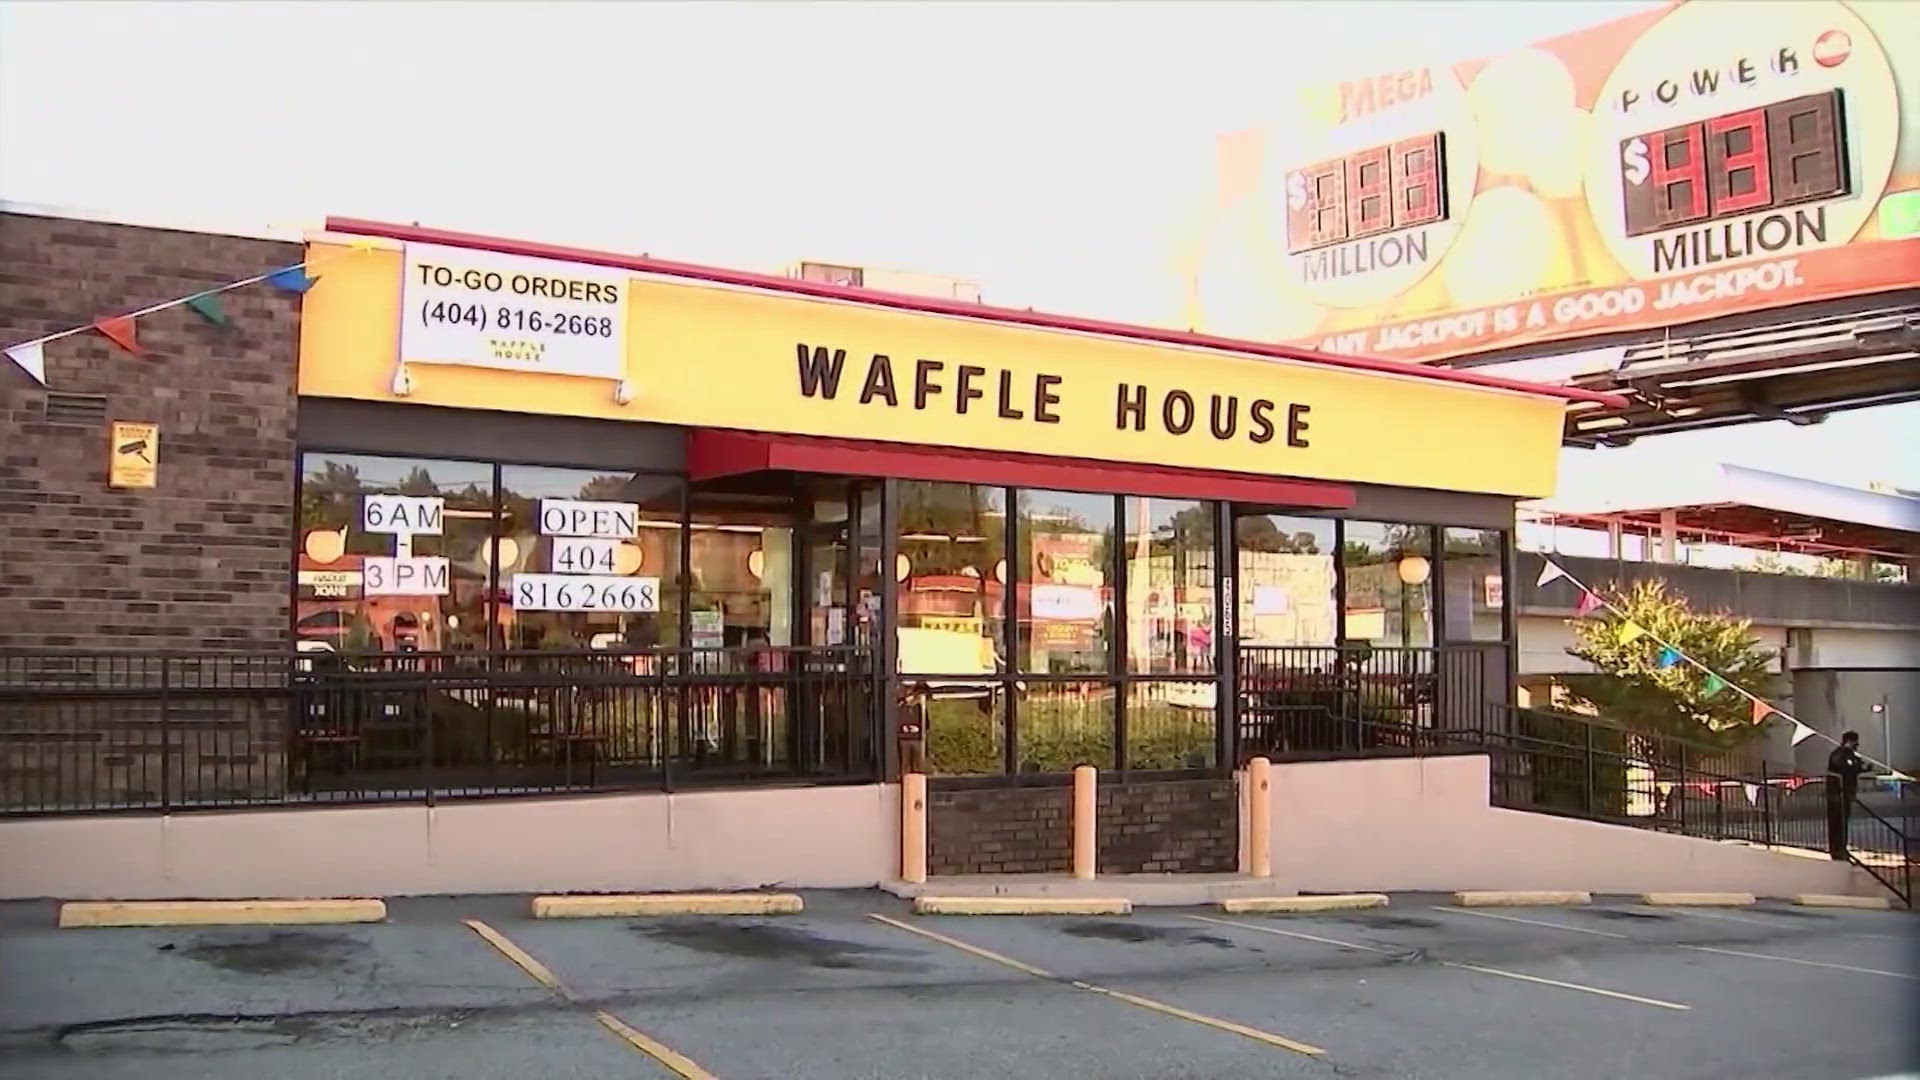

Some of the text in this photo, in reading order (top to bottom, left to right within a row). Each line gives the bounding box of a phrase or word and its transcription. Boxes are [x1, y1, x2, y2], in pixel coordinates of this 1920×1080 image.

[1338, 67, 1435, 121] MEGA
[1618, 47, 1799, 113] POWER
[1303, 231, 1428, 284] MILLION
[1654, 207, 1827, 273] MILLION
[417, 264, 618, 304] TO-GO ORDERS
[421, 299, 613, 338] (404) 816-2668
[1374, 311, 1487, 351] JACKPOT
[1493, 306, 1519, 333] IS
[1525, 302, 1546, 329] A
[1552, 287, 1646, 325] GOOD
[1654, 260, 1804, 310] JACKPOT.
[796, 343, 1312, 449] WAFFLE HOUSE
[366, 502, 442, 528] 6AM
[544, 507, 637, 534] OPEN
[367, 563, 448, 589] 3PM
[558, 546, 616, 572] 404
[519, 581, 655, 610] 8162668
